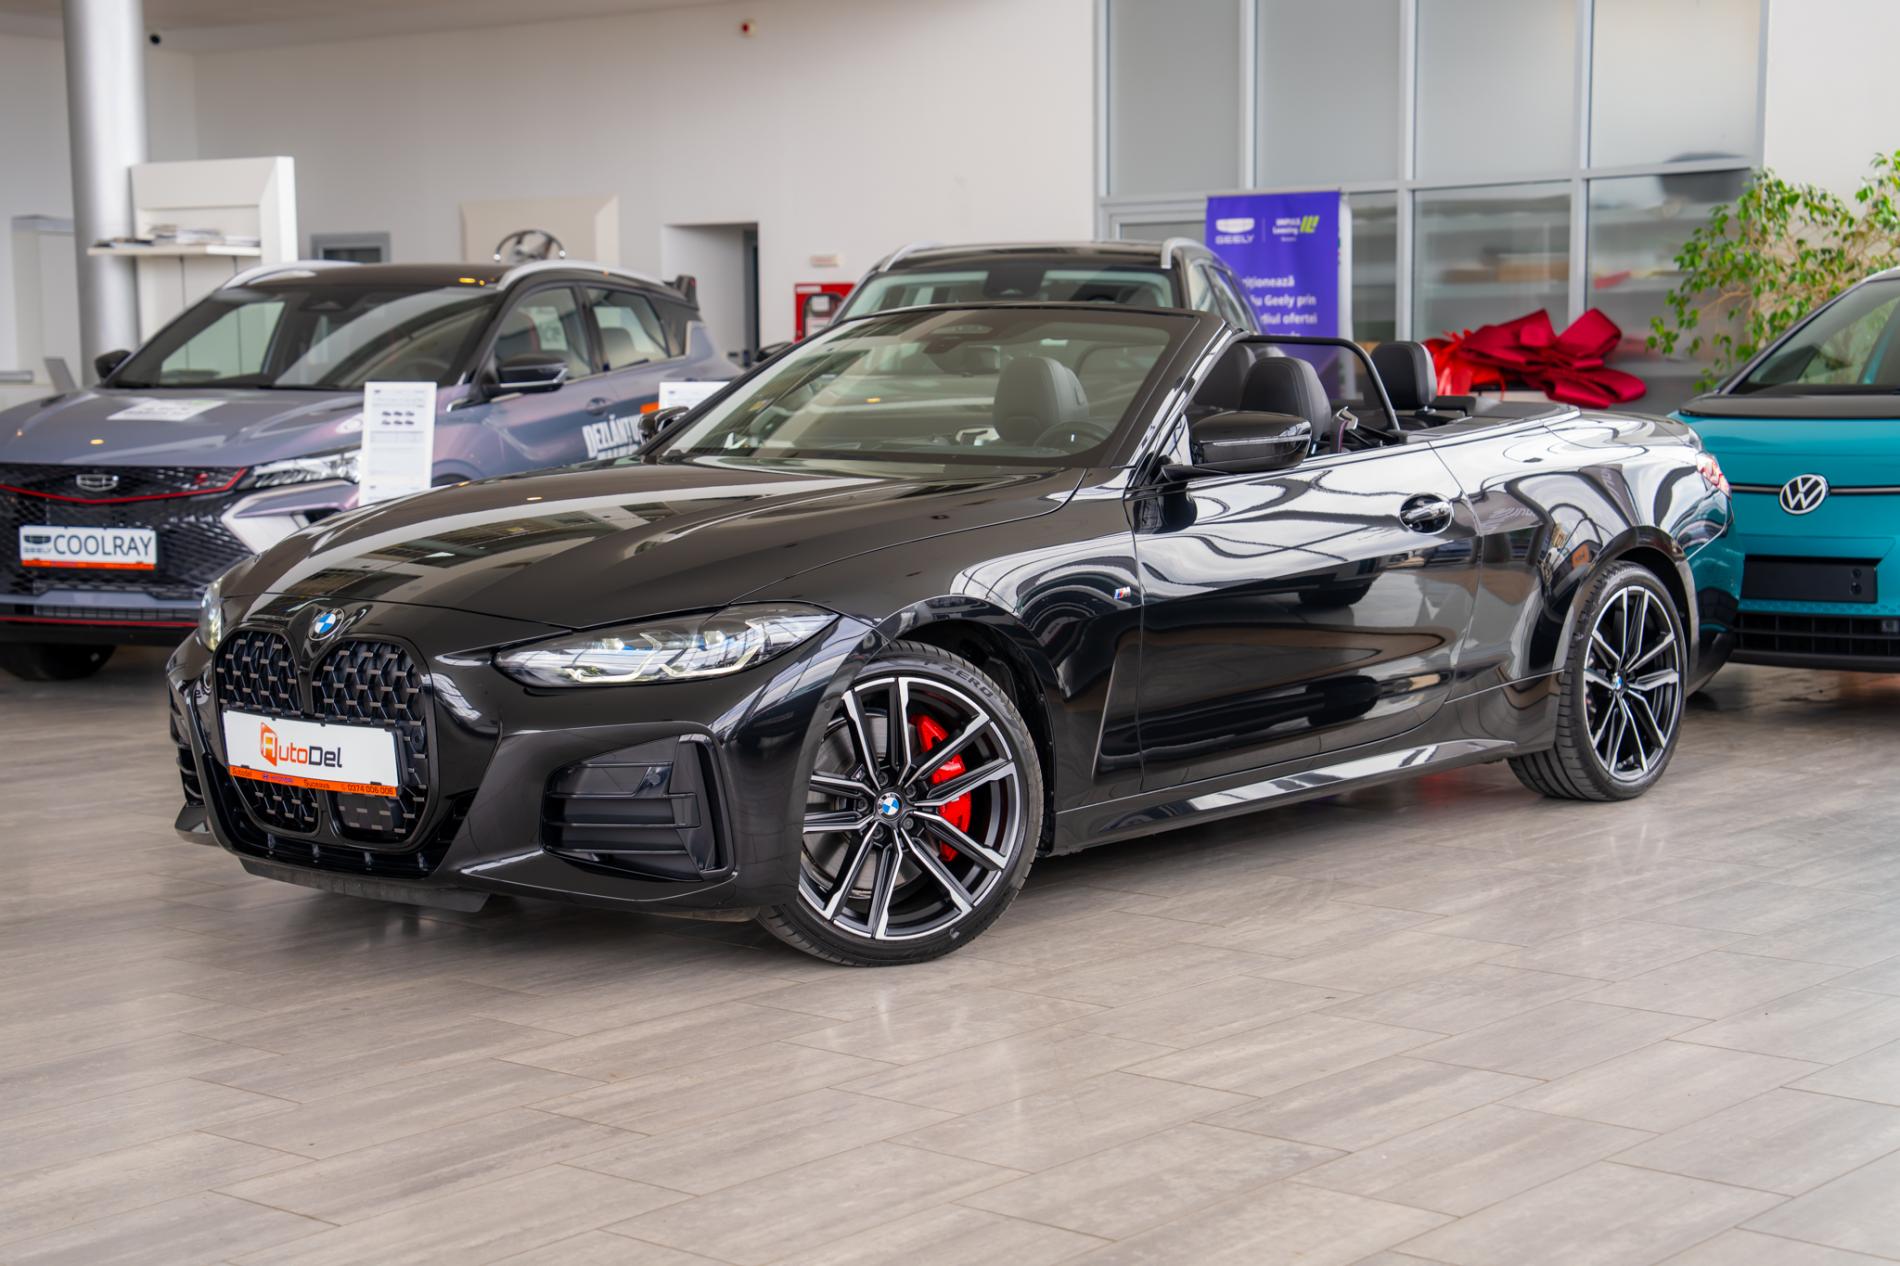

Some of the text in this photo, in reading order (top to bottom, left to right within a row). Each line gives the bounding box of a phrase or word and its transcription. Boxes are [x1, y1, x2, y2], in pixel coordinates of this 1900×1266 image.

[1264, 294, 1295, 308] Geely
[1296, 294, 1317, 308] prin
[53, 534, 153, 556] COOLRAY
[941, 663, 994, 698] ZERO
[260, 722, 343, 768] AutoDel
